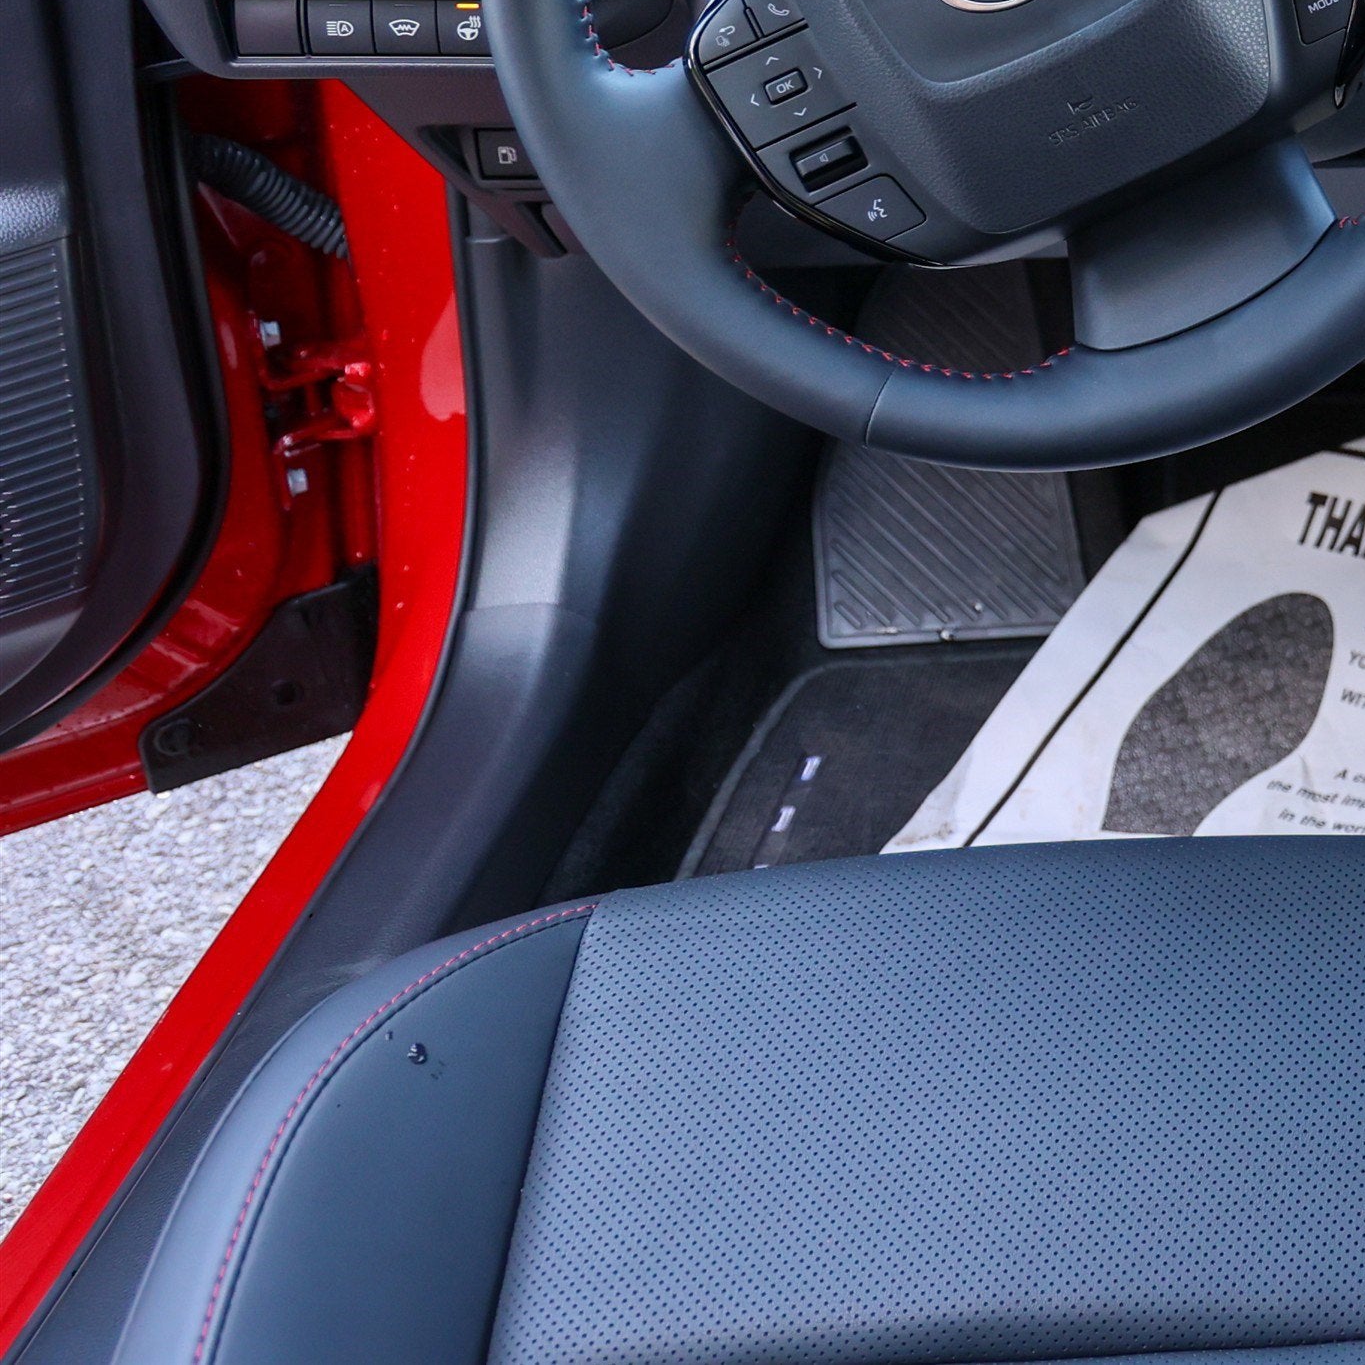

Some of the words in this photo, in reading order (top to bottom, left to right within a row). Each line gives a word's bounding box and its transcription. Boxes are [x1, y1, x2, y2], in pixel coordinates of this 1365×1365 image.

[775, 79, 795, 94] OK
[1048, 122, 1080, 147] SRS
[1079, 96, 1140, 133] AIRBAG
[1333, 768, 1349, 781] A
[1265, 779, 1292, 793] the
[1296, 786, 1339, 805] most
[1277, 807, 1296, 822] in
[1299, 814, 1327, 829] the
